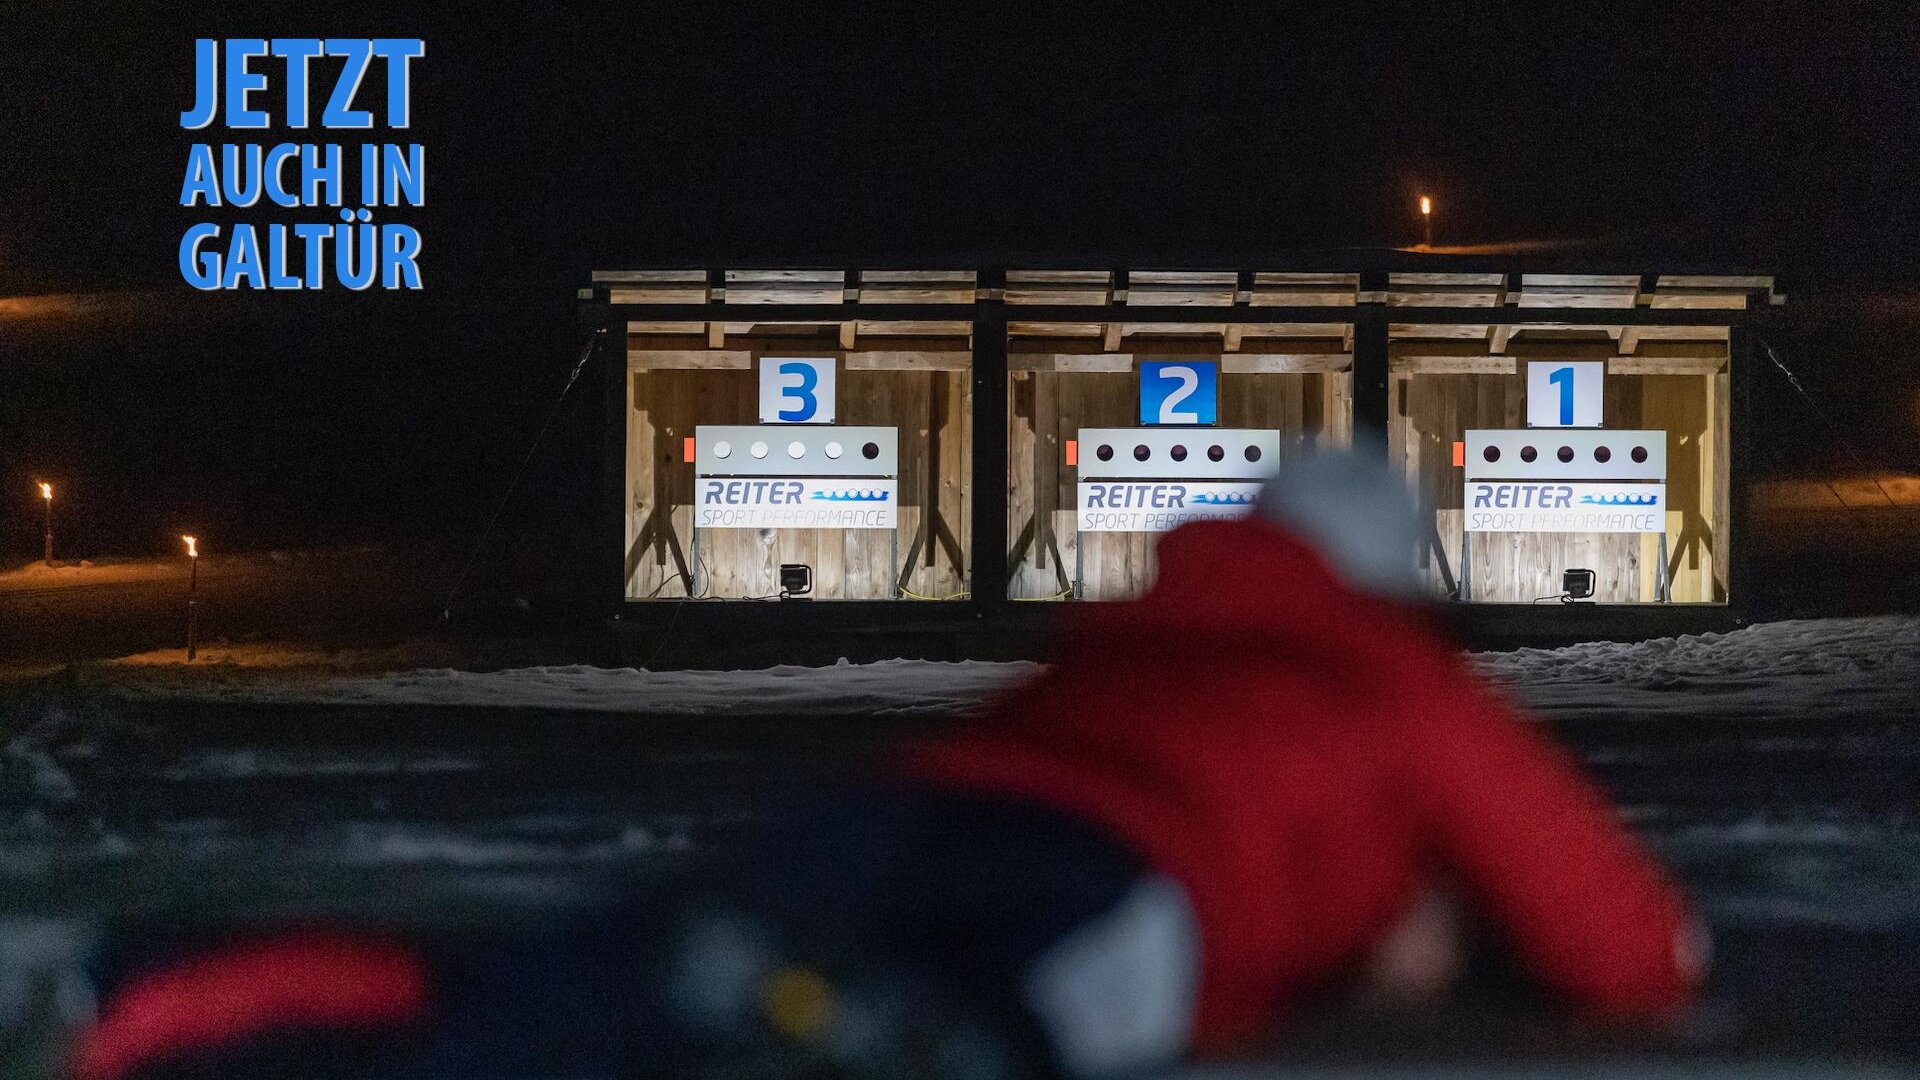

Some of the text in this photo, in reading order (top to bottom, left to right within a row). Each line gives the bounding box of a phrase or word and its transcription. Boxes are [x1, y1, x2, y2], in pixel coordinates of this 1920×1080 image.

[778, 362, 818, 422] 3
[1158, 366, 1199, 424] 2
[1549, 367, 1575, 426] 1
[704, 481, 804, 505] REITER
[1087, 485, 1187, 509] REITER
[1474, 485, 1574, 509] REITER
[702, 509, 887, 527] SPORT PERFORMANCE
[1085, 512, 1141, 530] SPORT
[1471, 512, 1657, 531] SPORT PERFORMANCE
